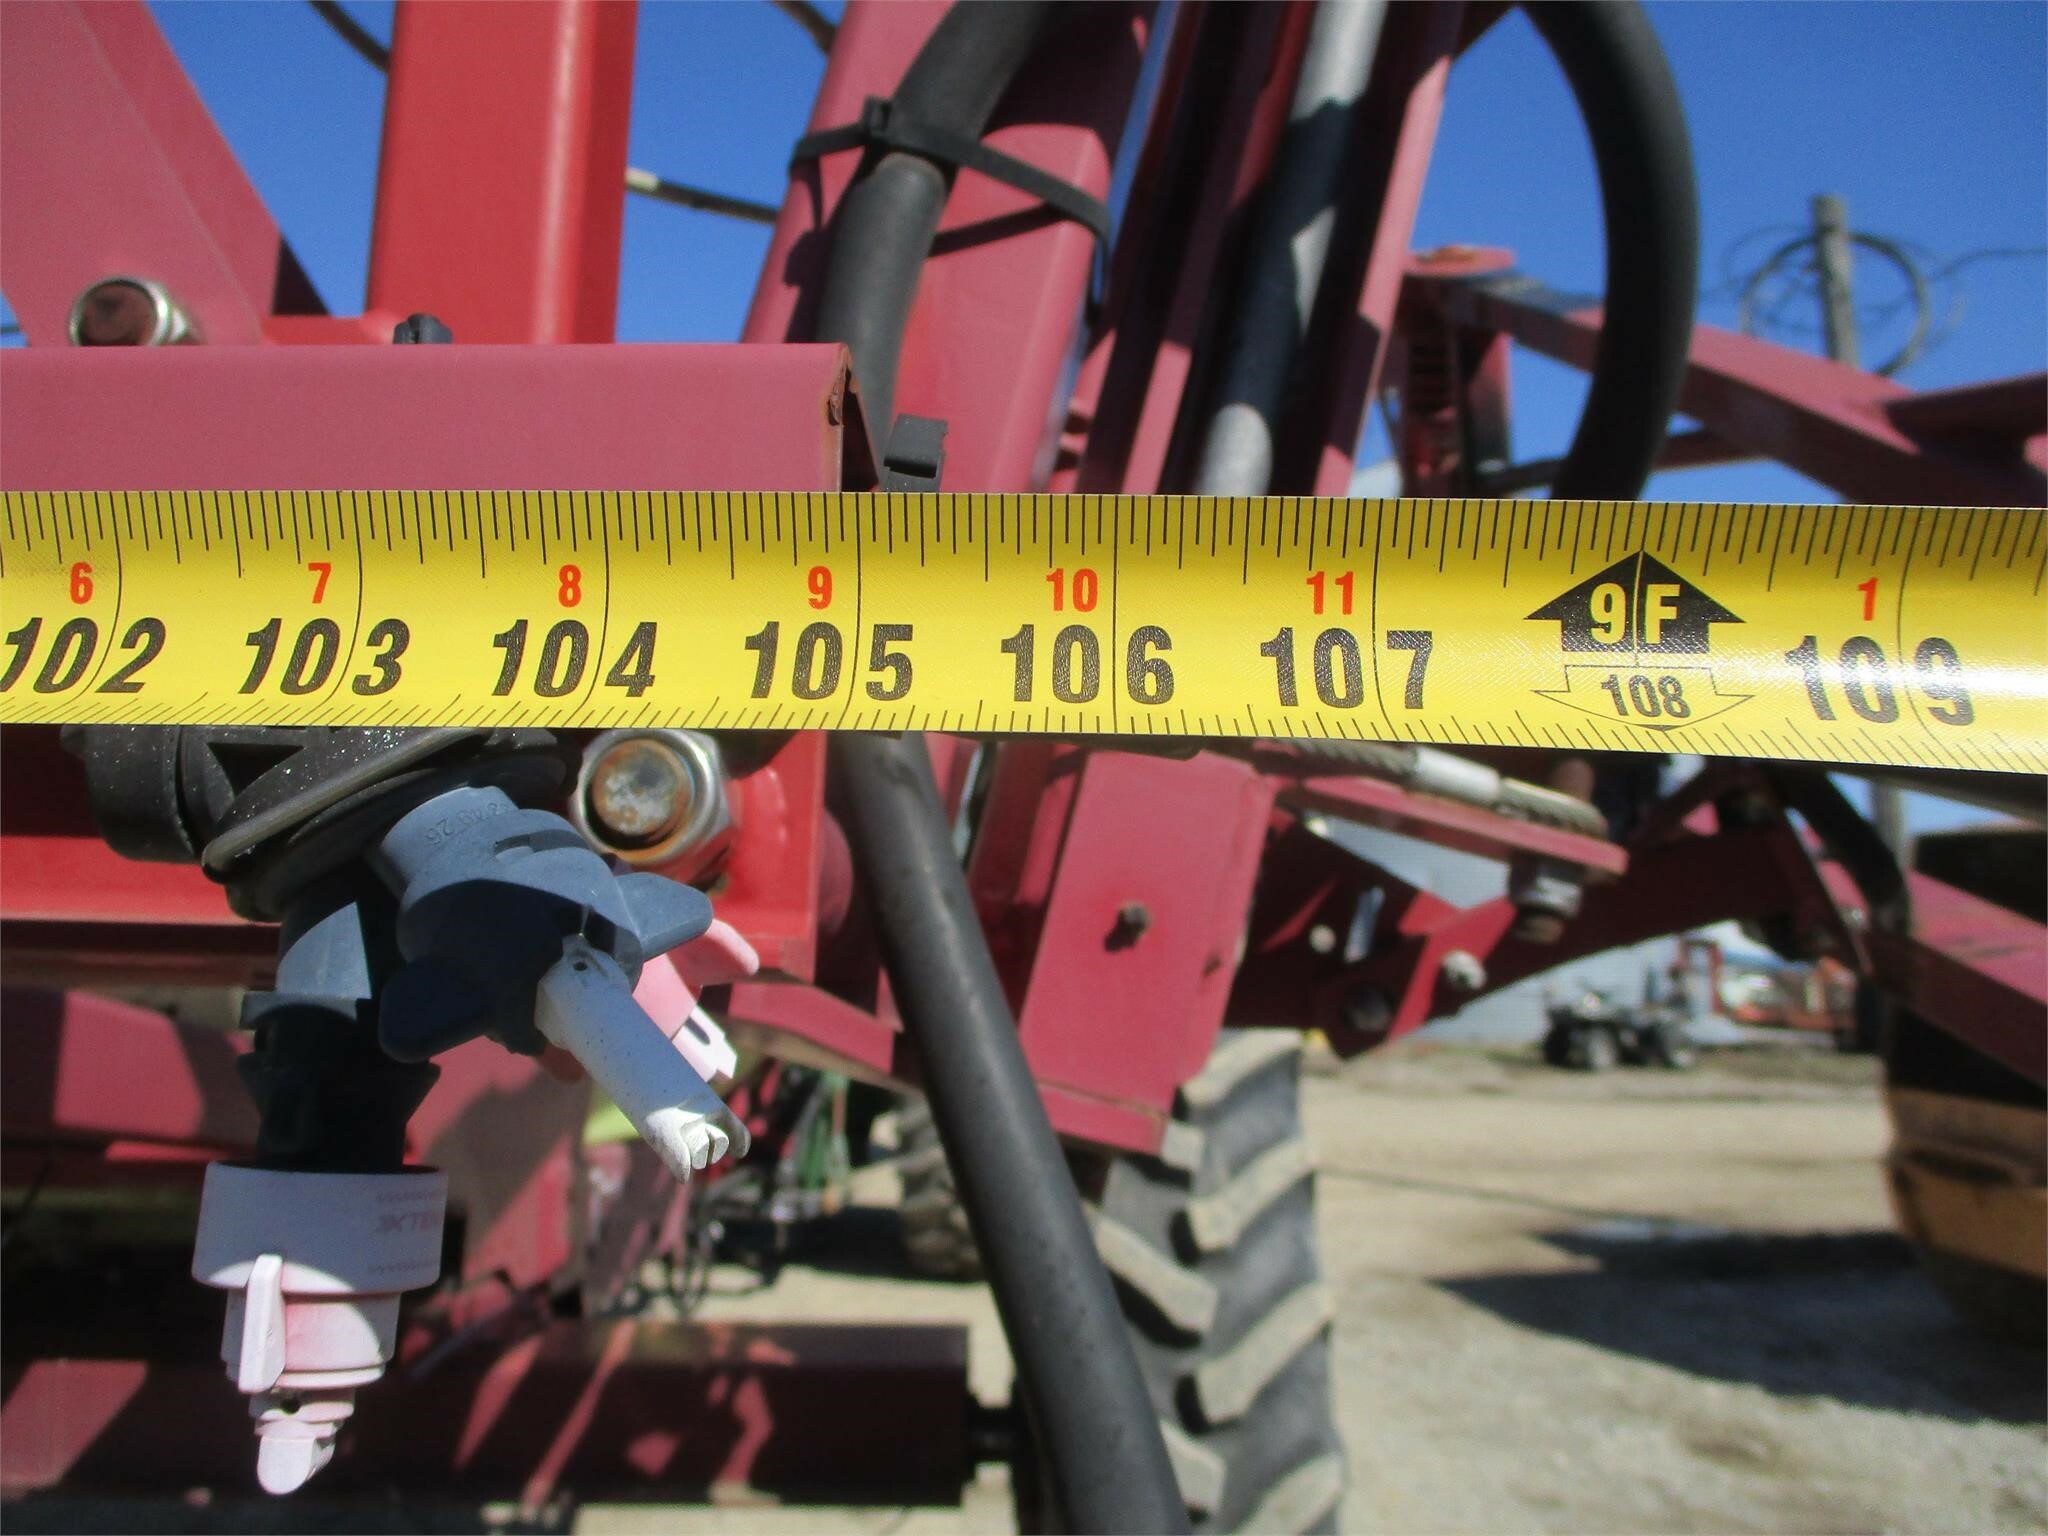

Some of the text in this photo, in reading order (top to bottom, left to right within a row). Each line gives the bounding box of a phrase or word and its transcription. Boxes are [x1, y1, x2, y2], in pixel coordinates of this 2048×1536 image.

[70, 562, 94, 604] 6
[308, 562, 332, 604] 7
[558, 565, 582, 607] 8
[807, 565, 833, 610] 9
[1046, 568, 1099, 613] 10
[1306, 571, 1355, 616] 11
[1857, 577, 1879, 621] 1
[0, 617, 166, 694] 102
[239, 617, 411, 695] 103
[492, 619, 657, 698] 104
[744, 621, 914, 702] 105
[1000, 624, 1175, 705] 106
[1260, 627, 1434, 710] 107
[1601, 674, 1692, 719] 108
[1784, 634, 1975, 727] 109
